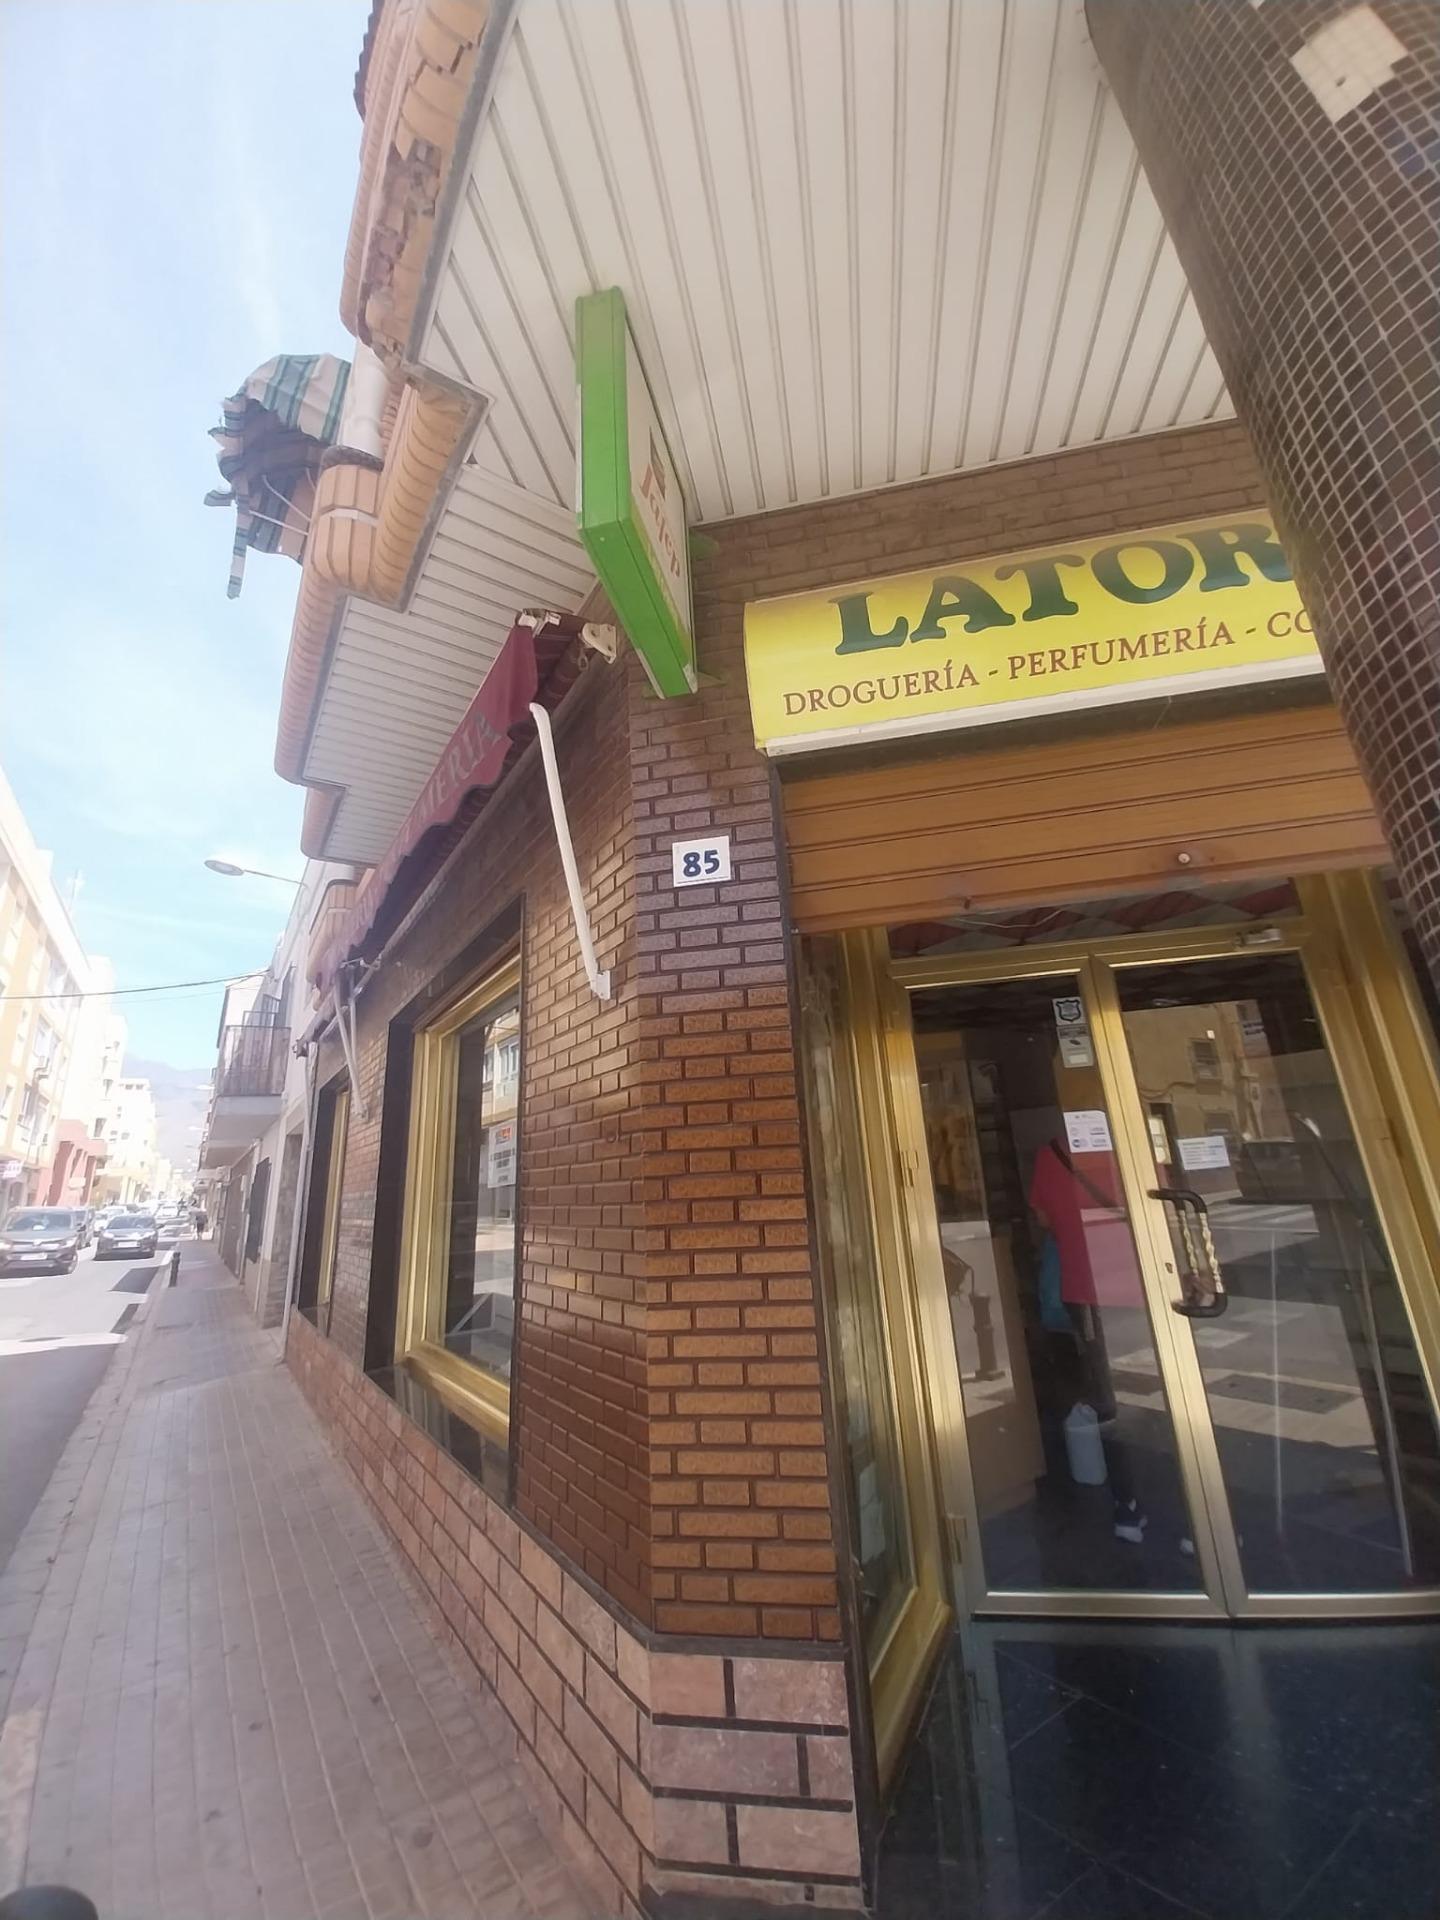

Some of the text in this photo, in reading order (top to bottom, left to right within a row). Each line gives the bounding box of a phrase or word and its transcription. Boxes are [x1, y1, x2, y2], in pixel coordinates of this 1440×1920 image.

[830, 522, 1293, 656] LATOR
[783, 659, 980, 716] DROGUERÍA
[1008, 616, 1236, 680] PERFUMERÍA
[683, 849, 720, 878] 85
